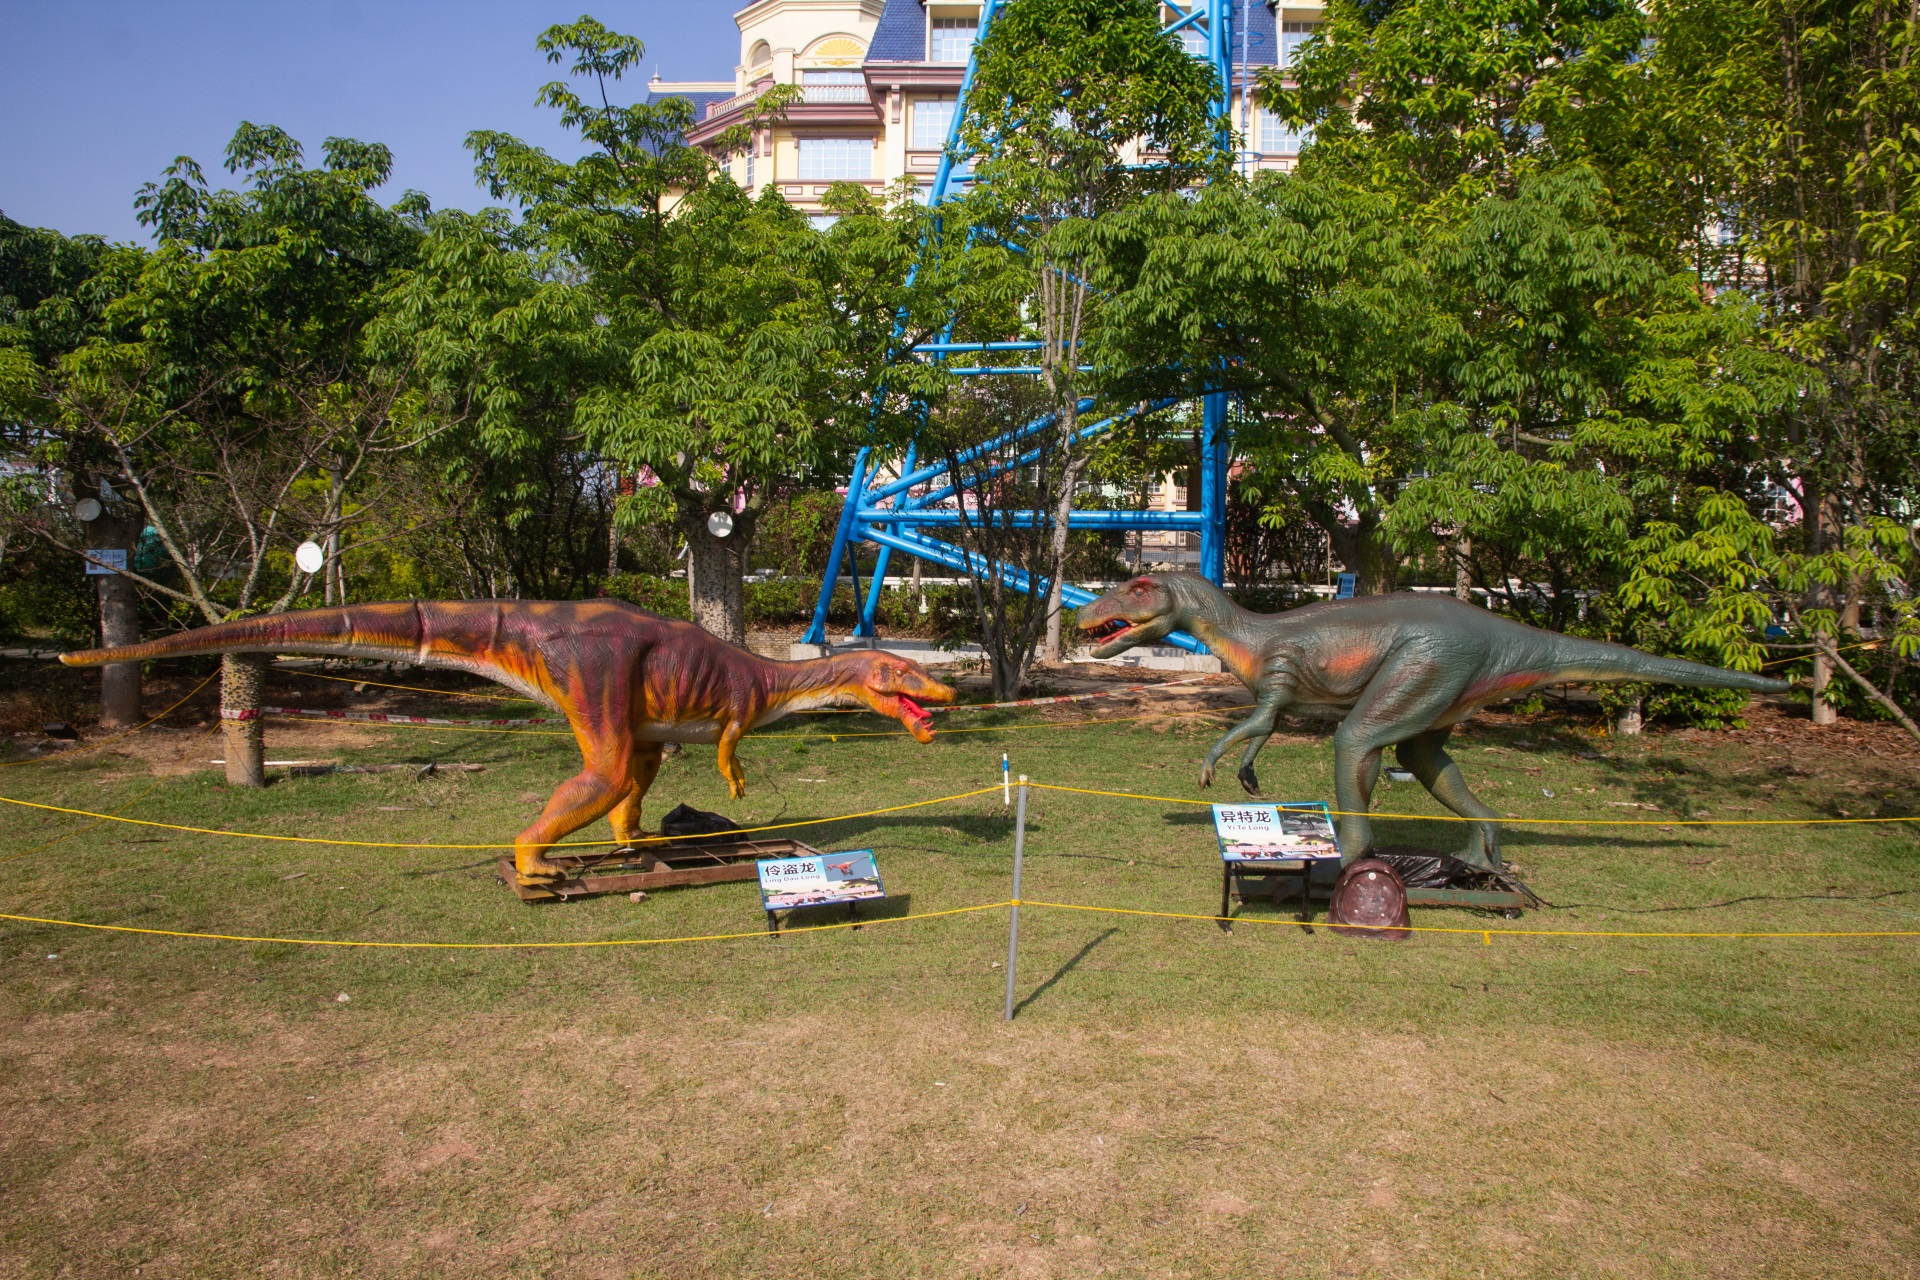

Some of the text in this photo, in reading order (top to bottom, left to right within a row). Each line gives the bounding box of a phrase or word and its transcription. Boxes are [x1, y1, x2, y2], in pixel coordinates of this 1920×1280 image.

[1221, 810, 1271, 823] 异特龙
[765, 862, 816, 876] 伶盗龙
